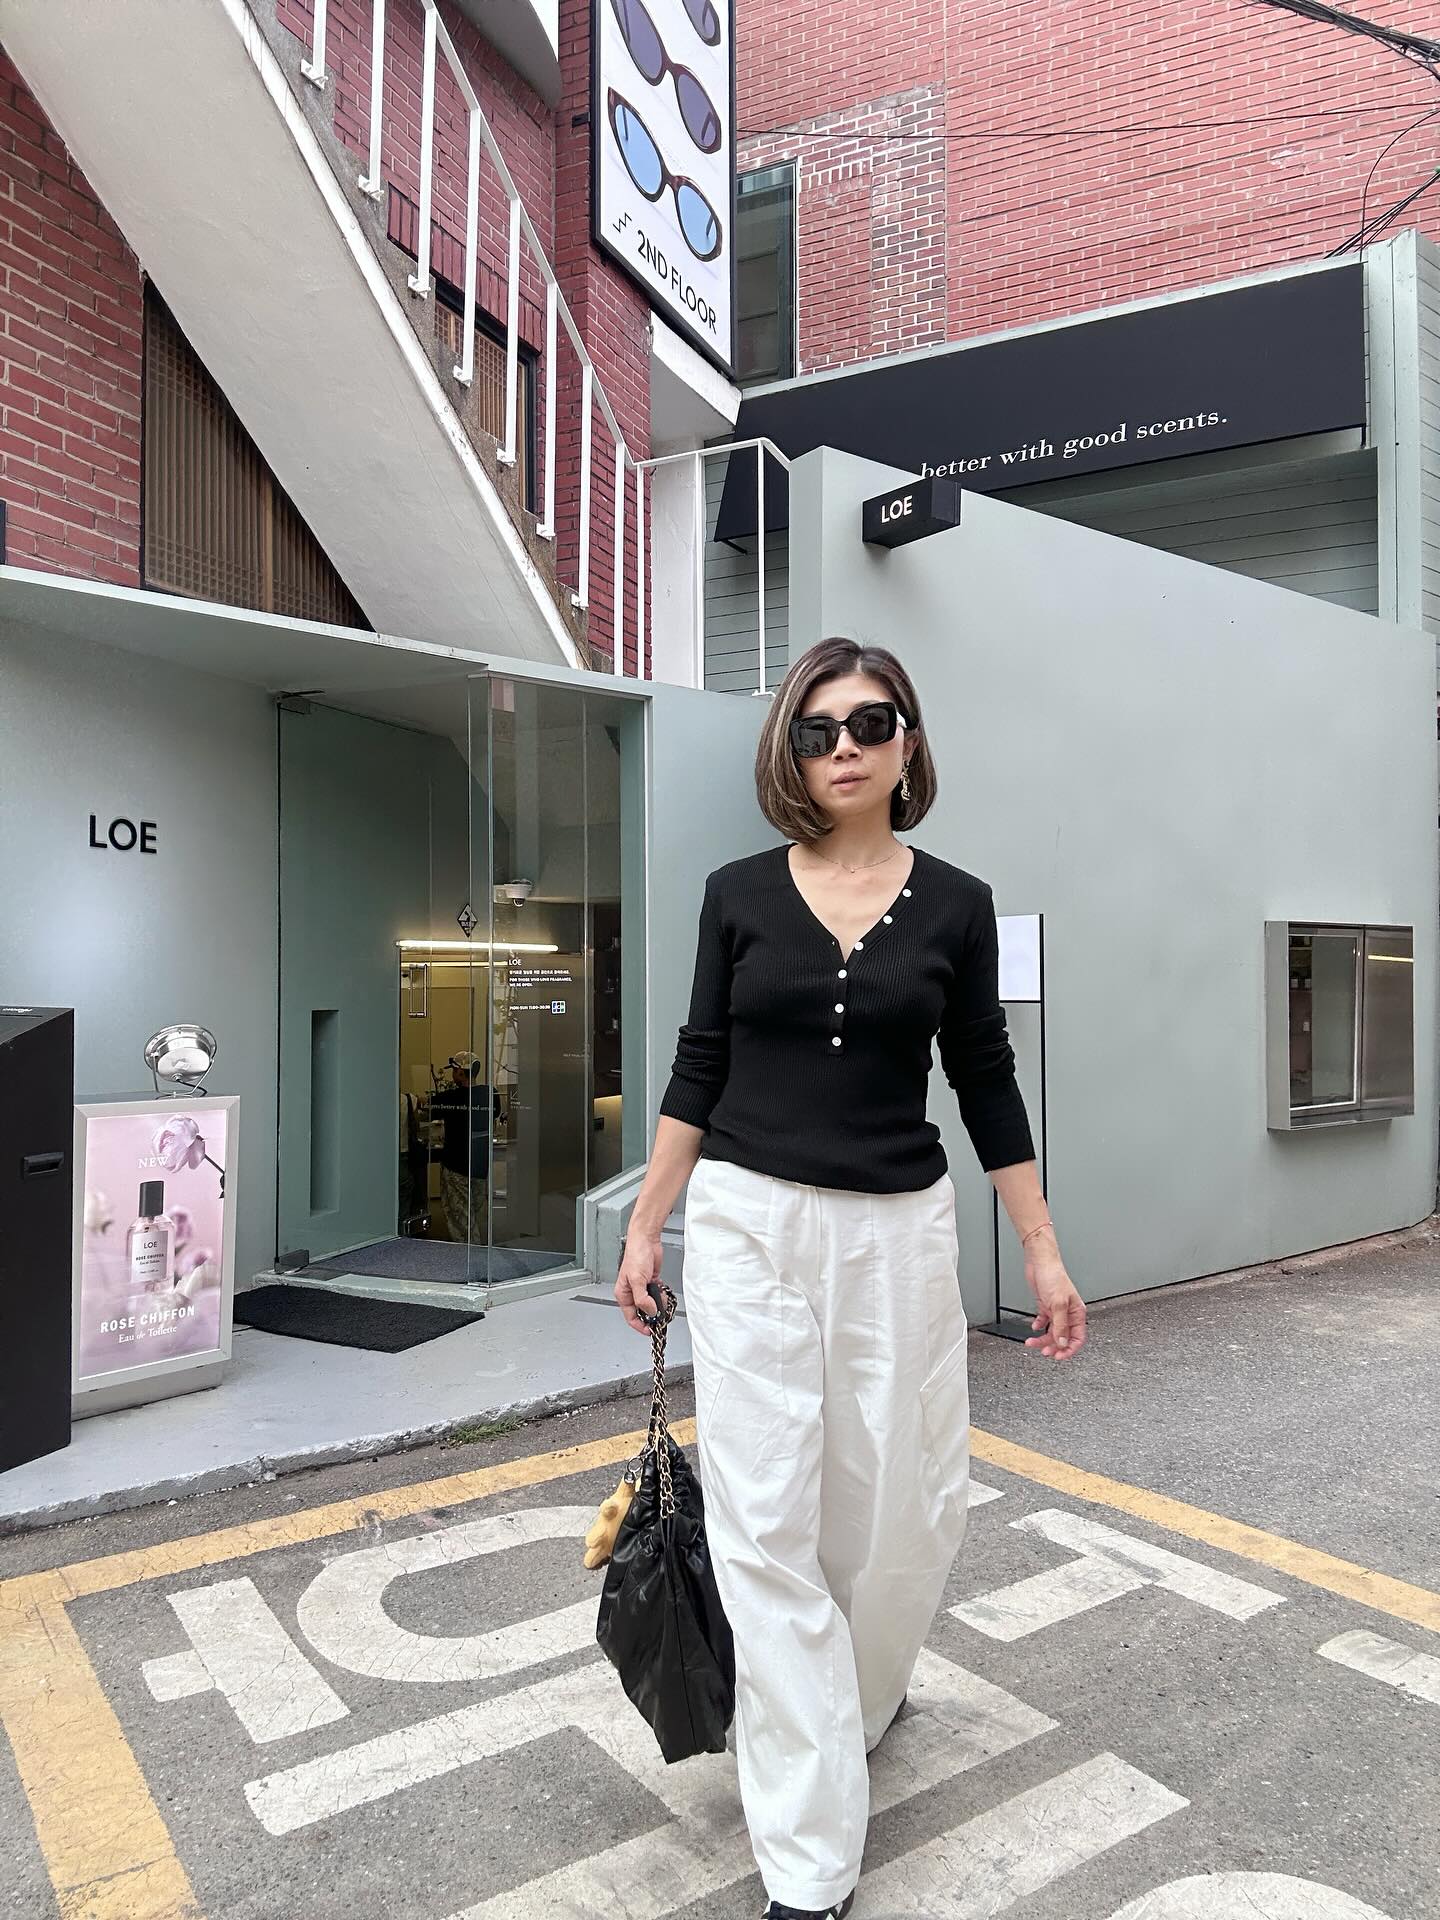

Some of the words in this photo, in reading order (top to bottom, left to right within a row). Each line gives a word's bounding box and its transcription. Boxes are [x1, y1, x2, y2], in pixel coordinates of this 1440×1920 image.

[637, 229, 668, 280] 2ND
[671, 266, 717, 335] FLOOR
[920, 462, 992, 479] better
[999, 439, 1055, 466] with
[1063, 423, 1128, 459] good
[1136, 410, 1229, 440] scents.
[880, 495, 913, 524] LOE
[89, 814, 157, 854] LOE
[138, 1156, 169, 1169] NEW
[143, 1241, 158, 1249] LOE
[100, 1317, 136, 1334] ROSE
[140, 1305, 195, 1326] CHIFFON
[118, 1334, 135, 1344] Eau
[136, 1331, 146, 1340] de
[147, 1324, 178, 1338] Toilette
